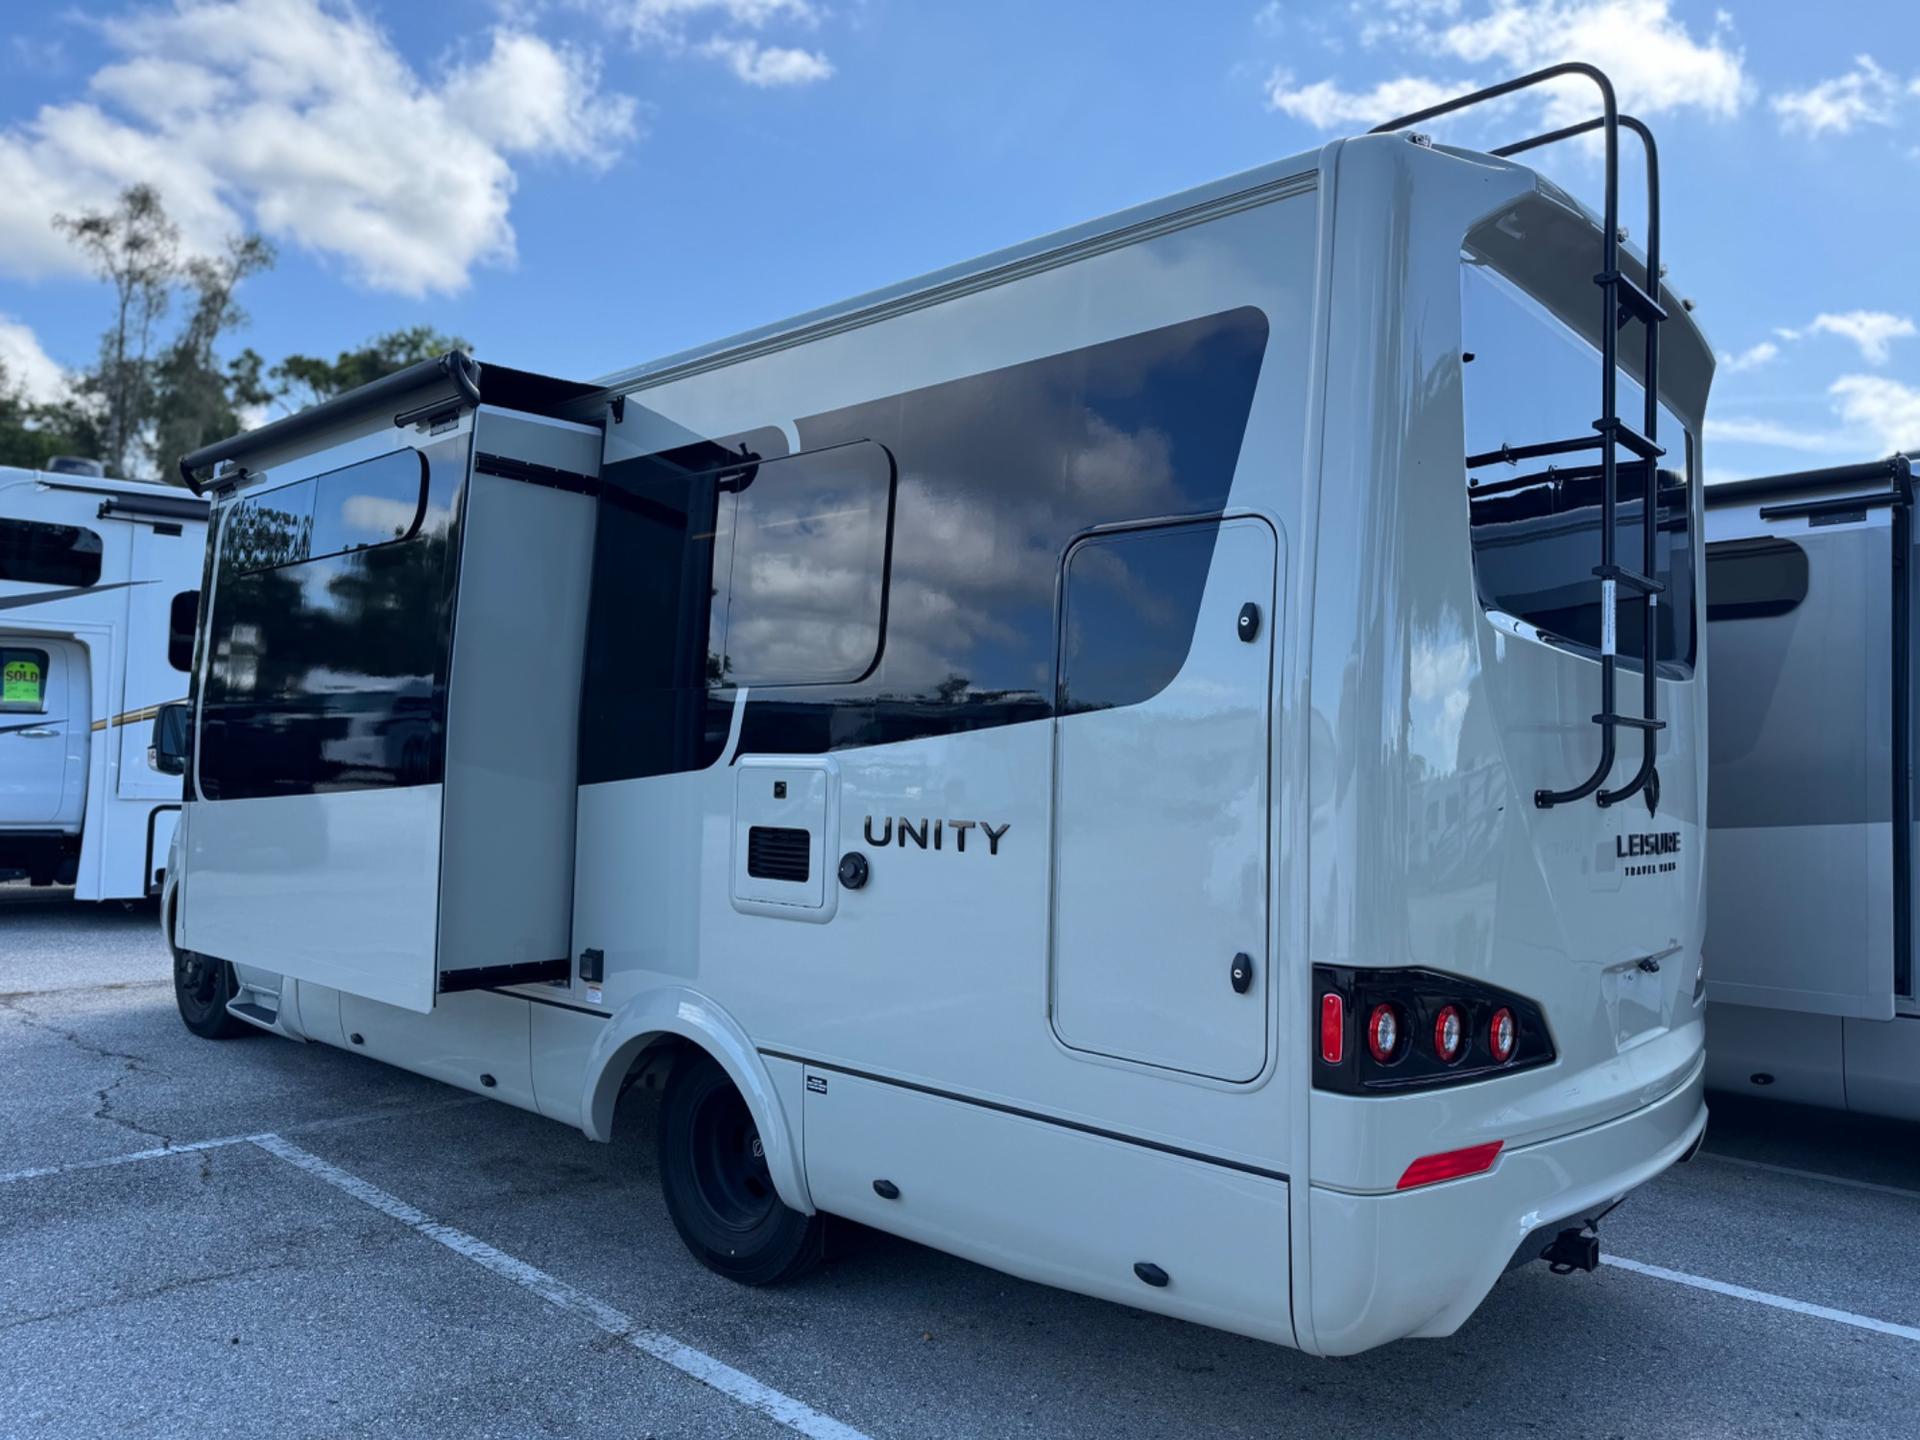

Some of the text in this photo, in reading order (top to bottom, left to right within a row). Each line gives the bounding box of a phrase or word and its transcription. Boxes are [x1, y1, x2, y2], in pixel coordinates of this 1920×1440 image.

[6, 670, 38, 683] SOLD
[864, 815, 1011, 855] UNITY
[1616, 832, 1680, 858] LEISURE
[1625, 865, 1656, 876] TRAVEL
